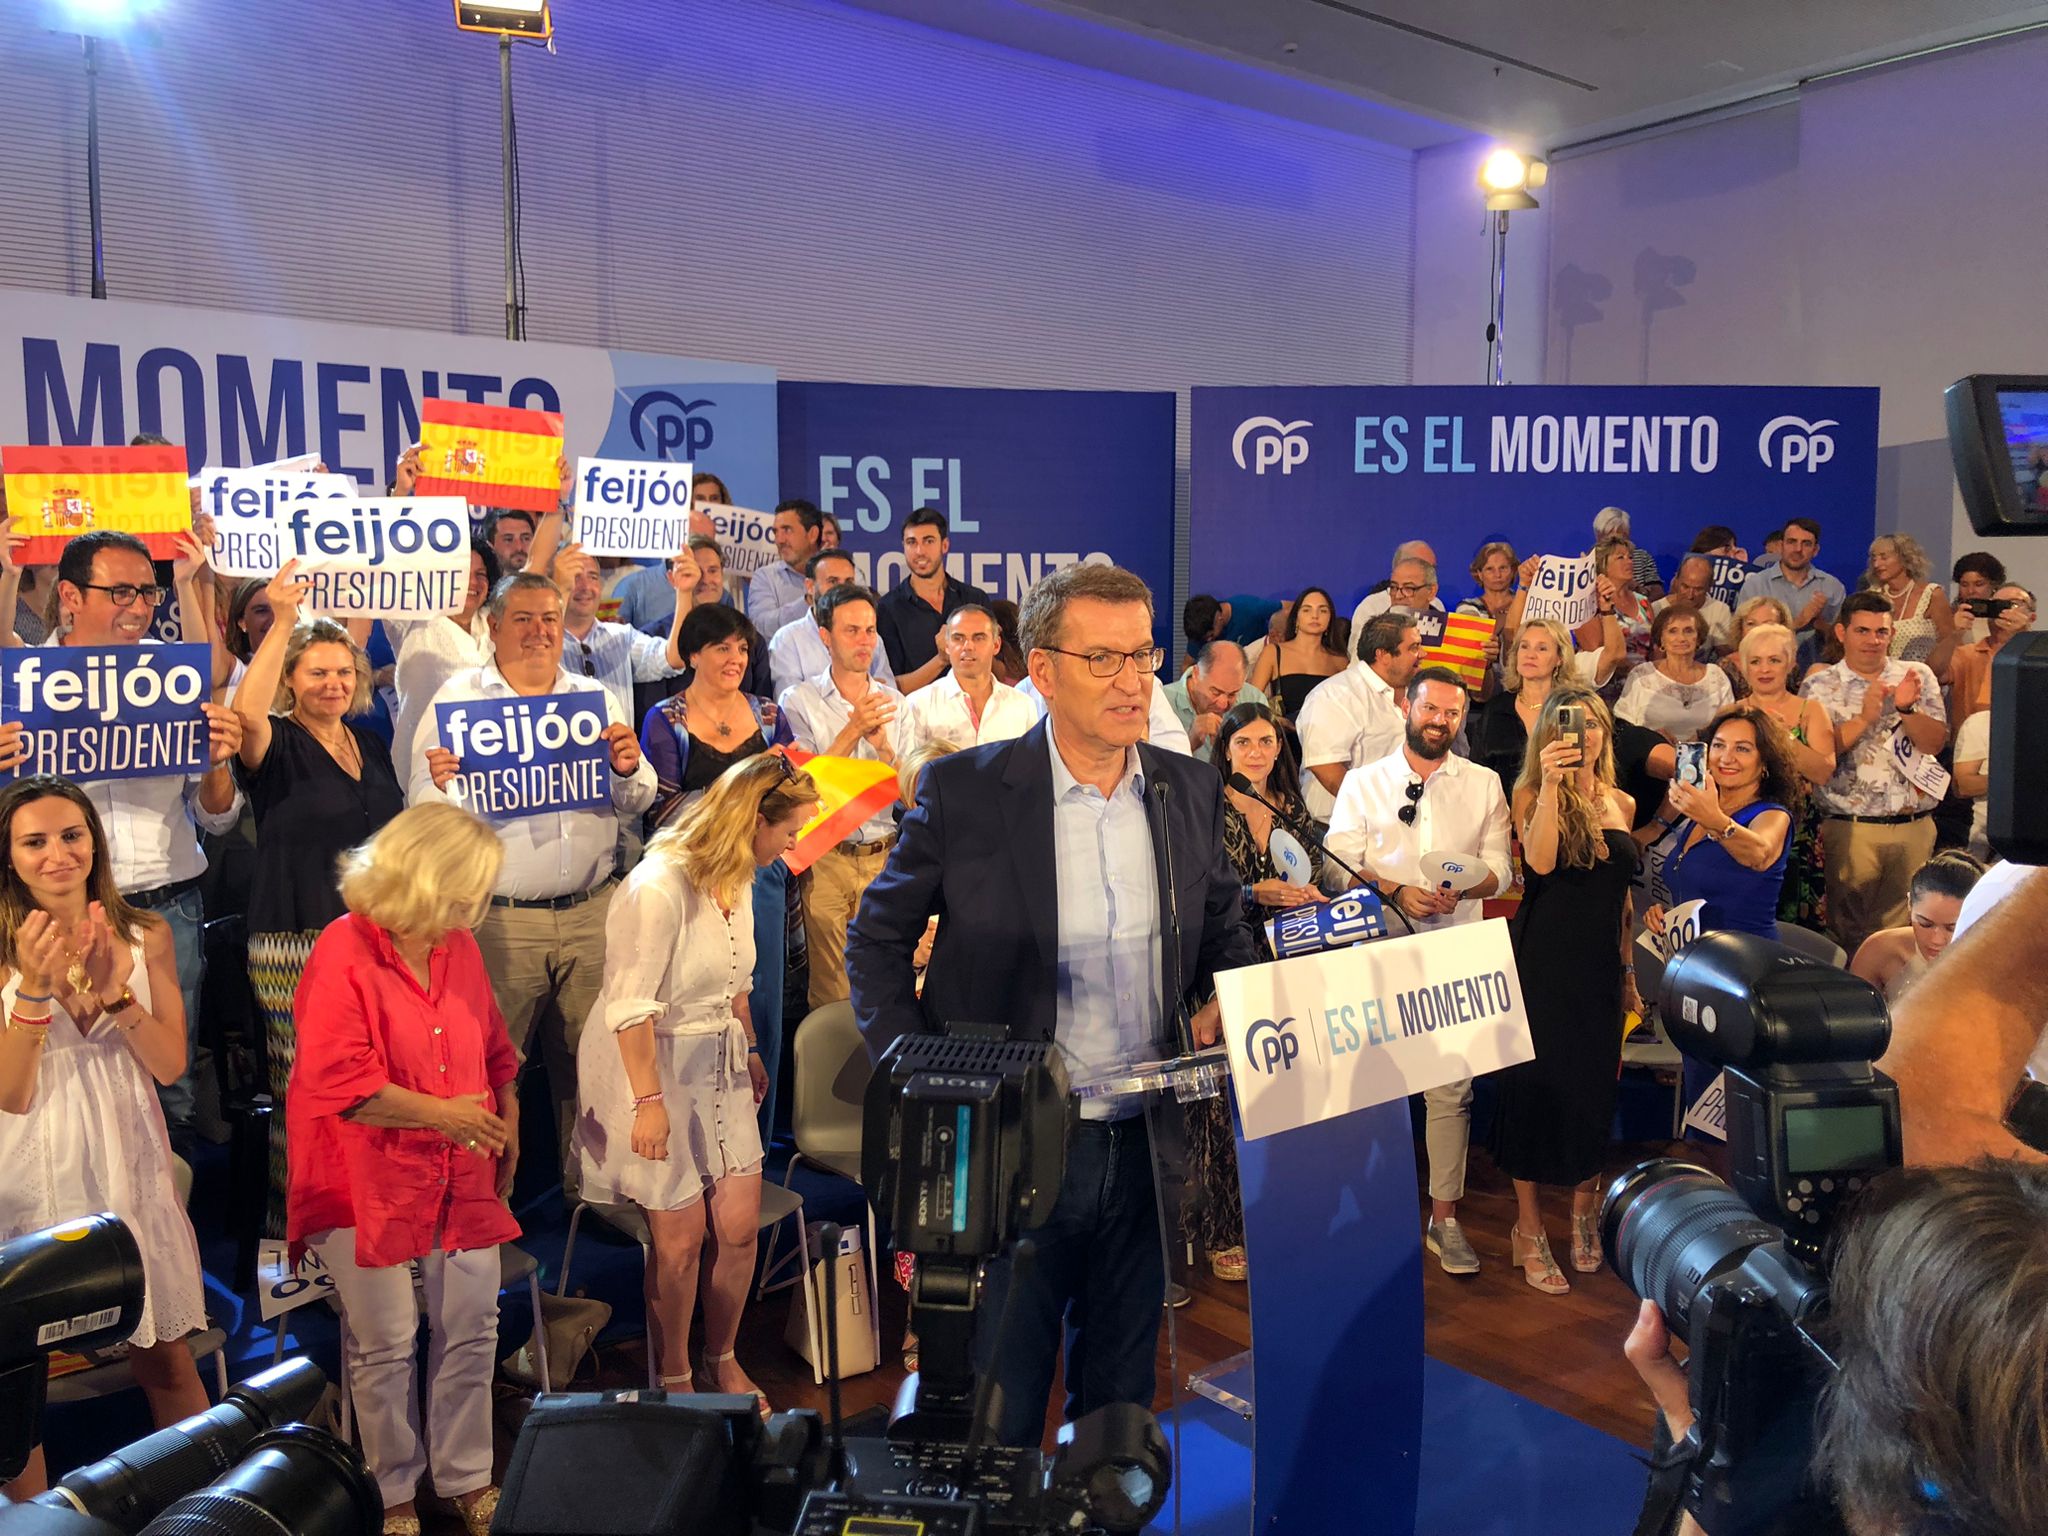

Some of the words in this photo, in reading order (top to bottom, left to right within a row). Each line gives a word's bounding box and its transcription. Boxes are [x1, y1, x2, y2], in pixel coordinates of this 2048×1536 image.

[23, 337, 561, 487] MOMEN
[657, 414, 714, 461] pp
[1256, 435, 1309, 475] pp
[1354, 415, 1409, 474] ES
[1423, 416, 1476, 473] EL
[1490, 415, 1720, 473] MOMENTO
[1781, 435, 1836, 473] pp
[584, 466, 688, 513] feijóo
[819, 456, 892, 533] ES
[211, 532, 281, 569] PRESI
[288, 507, 462, 566] feijóo
[13, 653, 202, 722] feijóo
[13, 719, 203, 778] PRESIDENTE
[446, 702, 602, 763] feijóo
[453, 758, 604, 815] PRESIDENTE
[1325, 888, 1380, 946] feij
[1262, 1032, 1299, 1074] pp
[1324, 1004, 1360, 1056] ES
[1362, 998, 1397, 1046] EL
[1396, 970, 1512, 1038] MOMENTO
